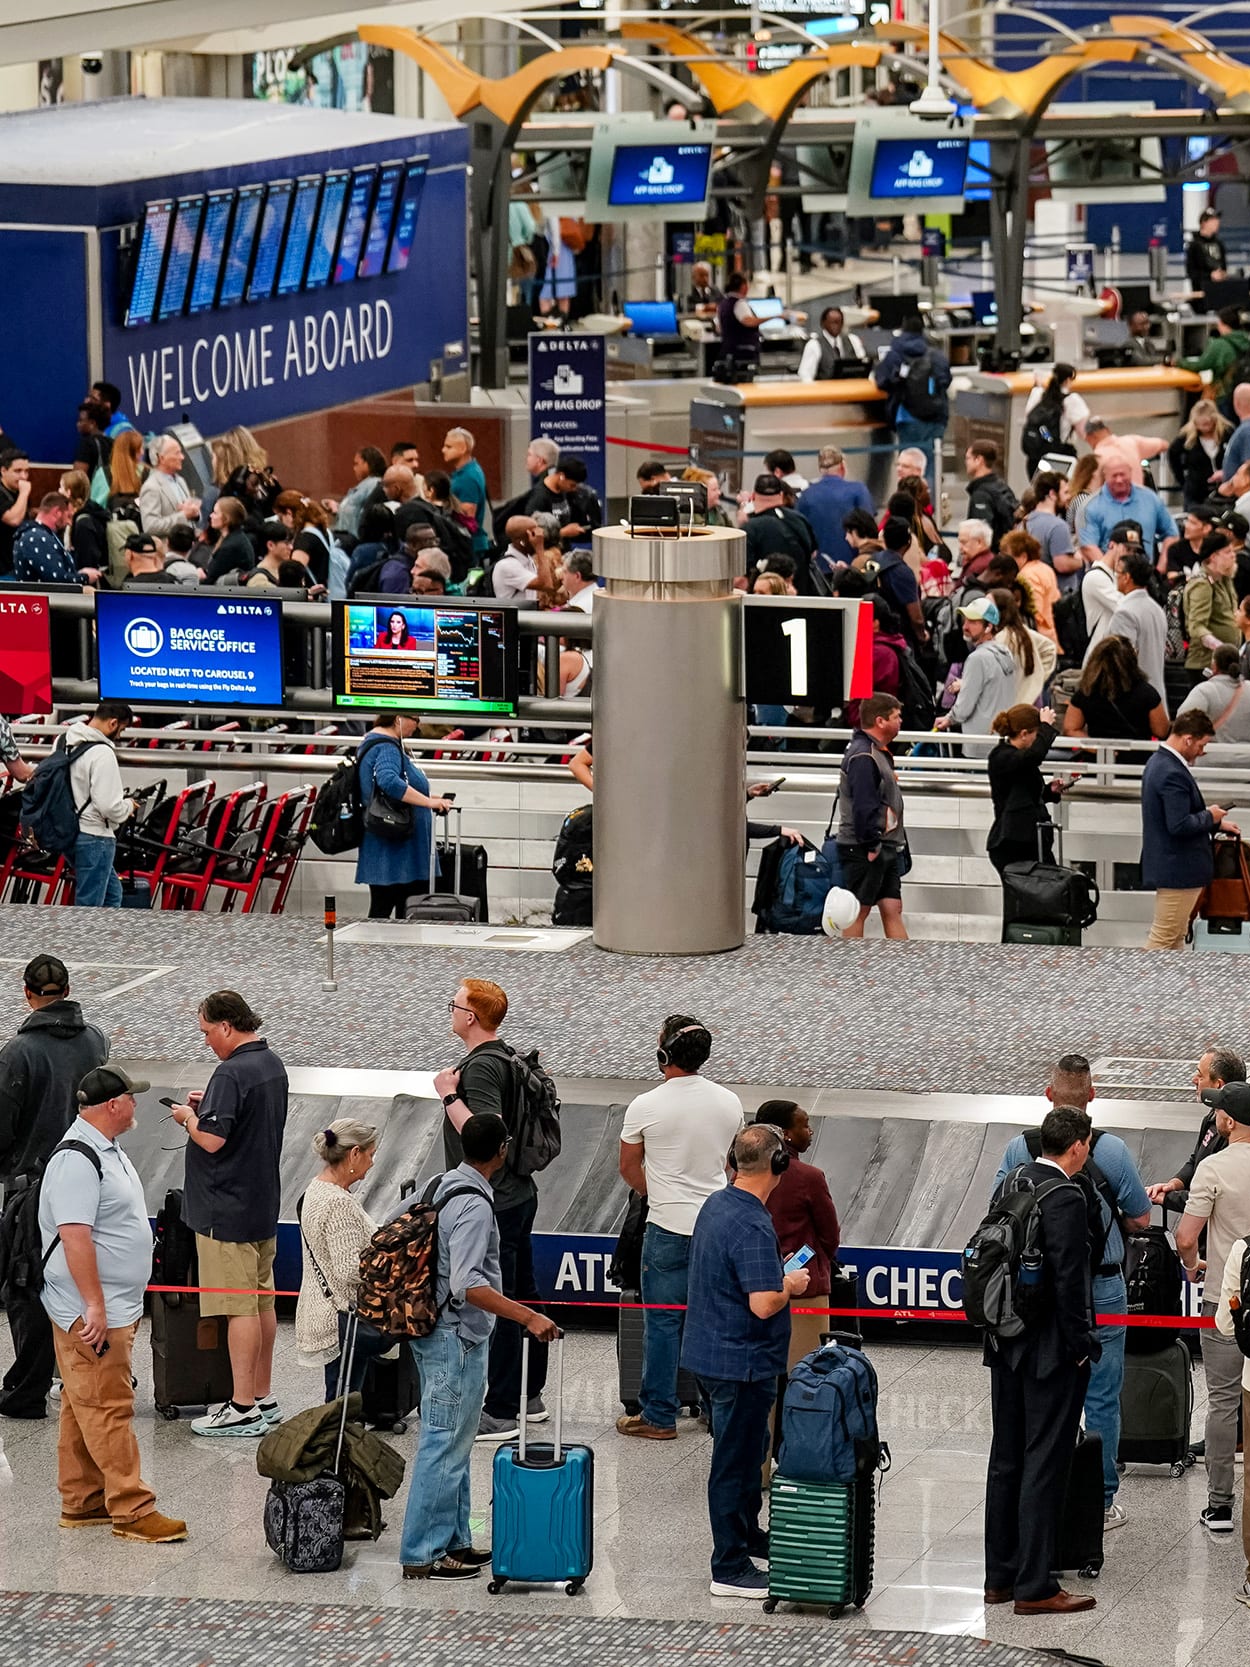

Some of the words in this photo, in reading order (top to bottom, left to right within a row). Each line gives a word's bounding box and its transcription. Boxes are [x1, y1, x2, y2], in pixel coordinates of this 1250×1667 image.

[549, 340, 588, 351] DELTA
[128, 324, 274, 416] WELCOME
[283, 299, 393, 381] ABOARD
[534, 400, 553, 410] APP
[554, 400, 574, 410] BAG
[575, 399, 602, 410] DROP
[0, 602, 27, 614] LTA
[228, 606, 262, 615] DELTA
[170, 628, 225, 641] BAGGAGE
[170, 641, 215, 652] SERVICE
[217, 642, 256, 653] OFFICE
[781, 618, 807, 696] 1
[130, 666, 167, 676] LOCATED
[169, 668, 190, 677] NEXT
[192, 669, 204, 677] TO
[204, 669, 247, 679] CAROUSEL
[248, 671, 254, 679] 9
[865, 1265, 963, 1309] CHEC
